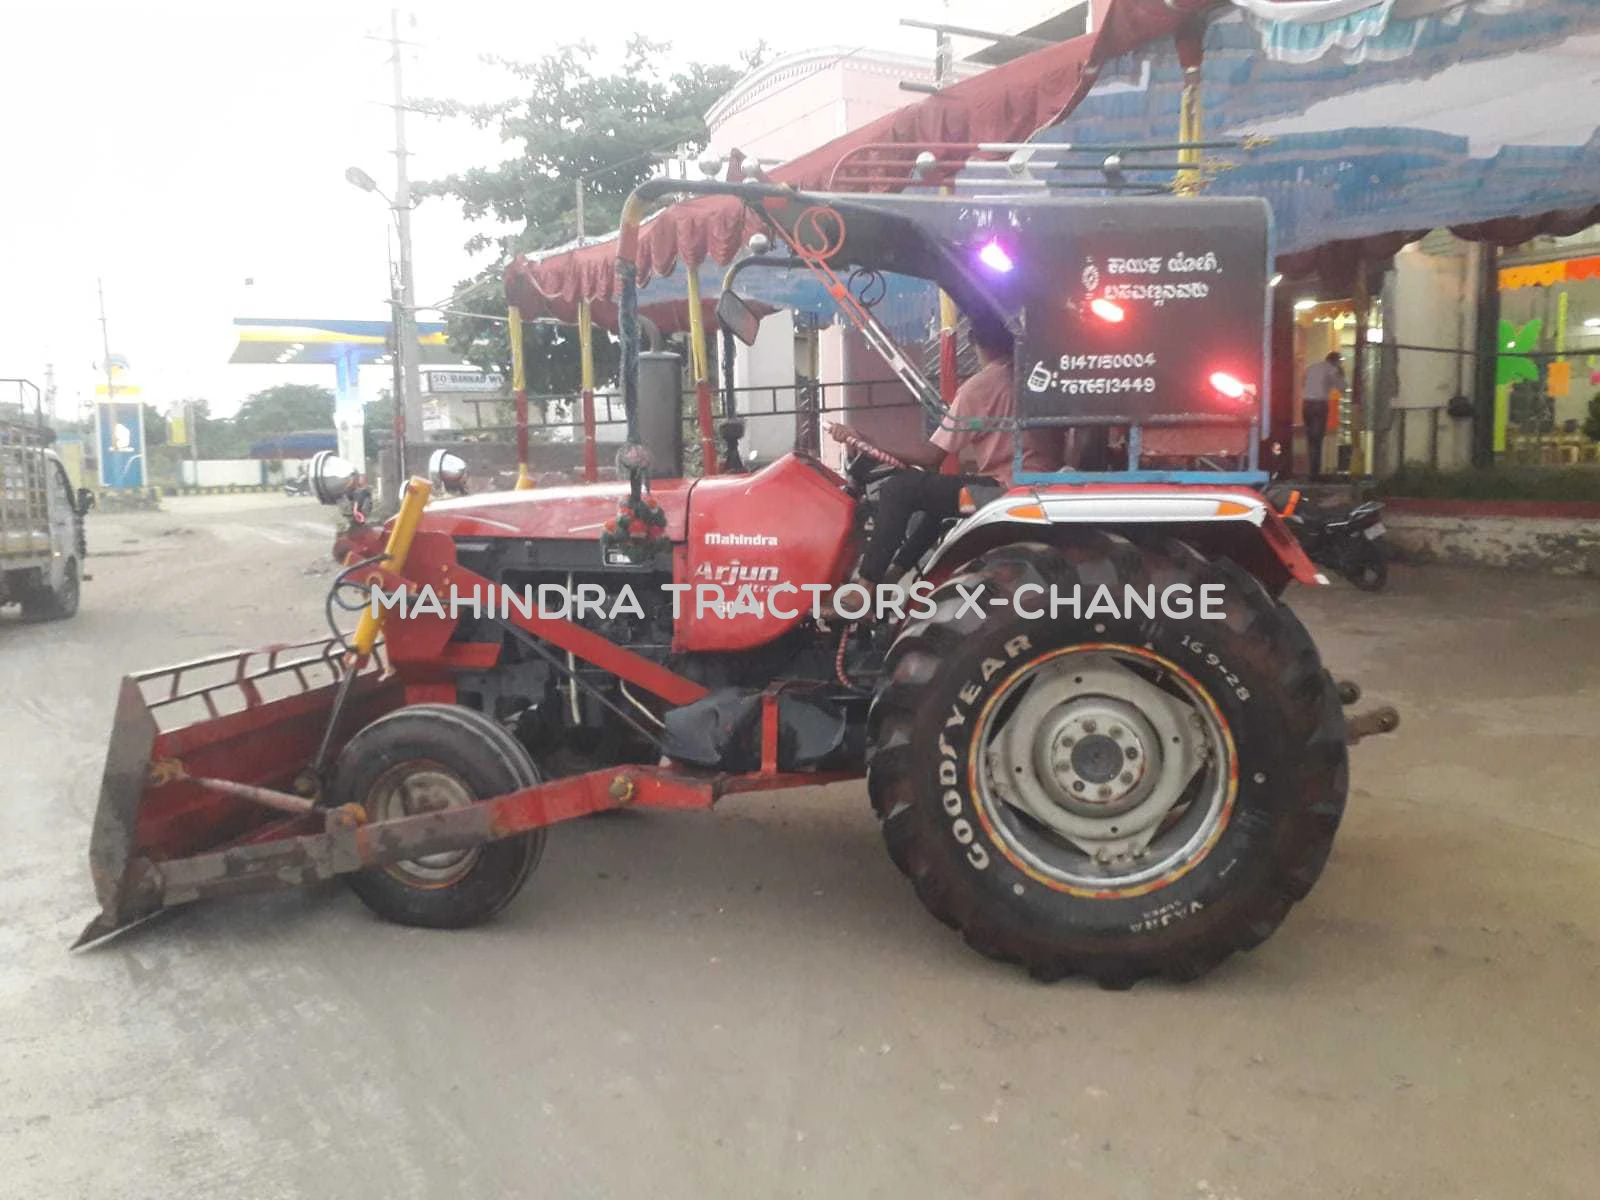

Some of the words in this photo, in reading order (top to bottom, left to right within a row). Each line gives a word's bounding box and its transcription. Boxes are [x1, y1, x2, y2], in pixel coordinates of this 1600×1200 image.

[1059, 352, 1157, 371] 8147150004
[1059, 377, 1156, 394] 7676513449
[704, 532, 778, 546] Mahindra
[694, 560, 780, 586] Arjun
[938, 634, 1033, 871] GOODYEAR
